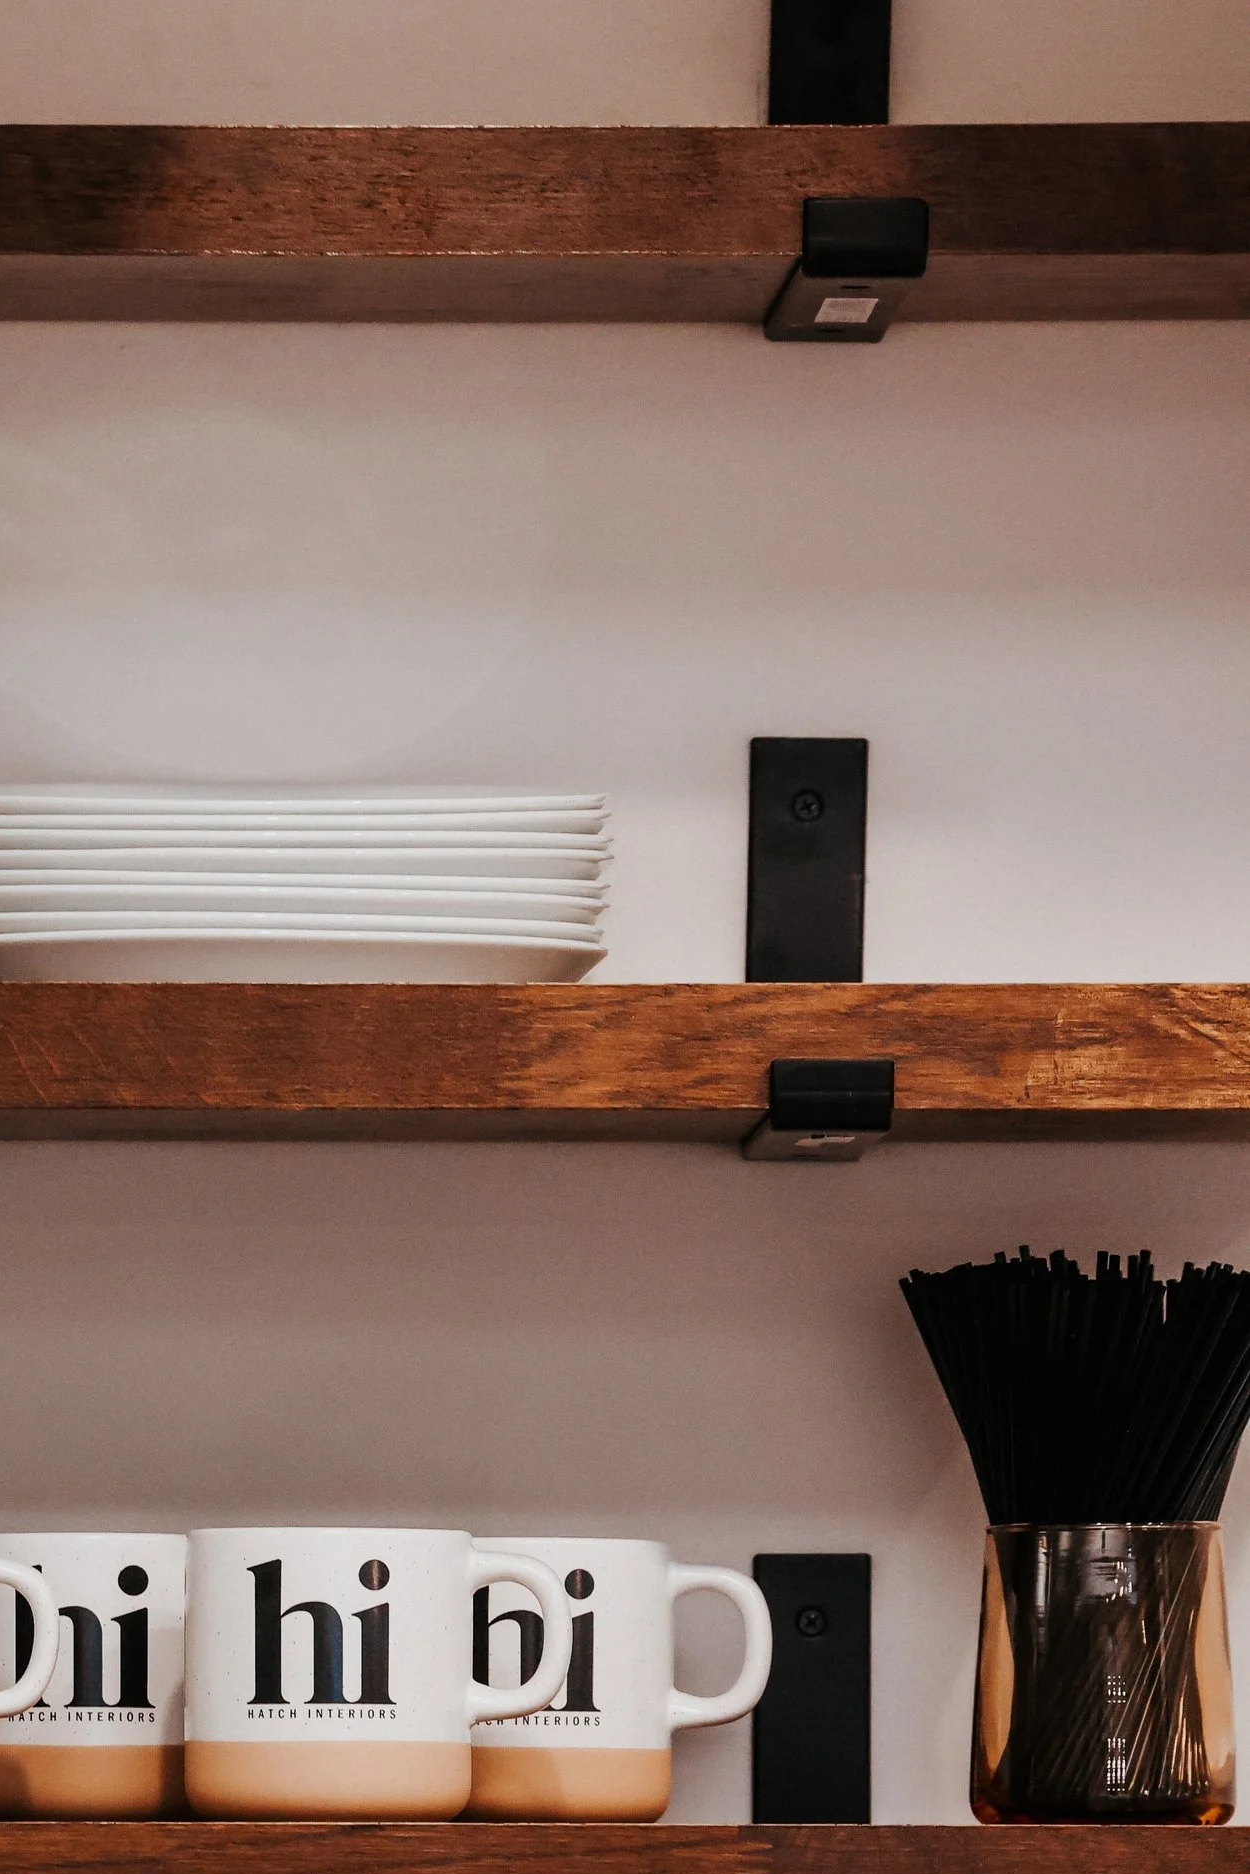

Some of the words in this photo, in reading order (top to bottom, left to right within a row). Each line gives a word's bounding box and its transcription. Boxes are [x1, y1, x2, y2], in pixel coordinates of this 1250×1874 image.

[246, 1558, 397, 1705] hi
[67, 1711, 156, 1723] INTERIORS
[247, 1708, 298, 1719] HATCH
[307, 1708, 397, 1720] INTERIORS
[514, 1716, 601, 1727] INTERIORS
